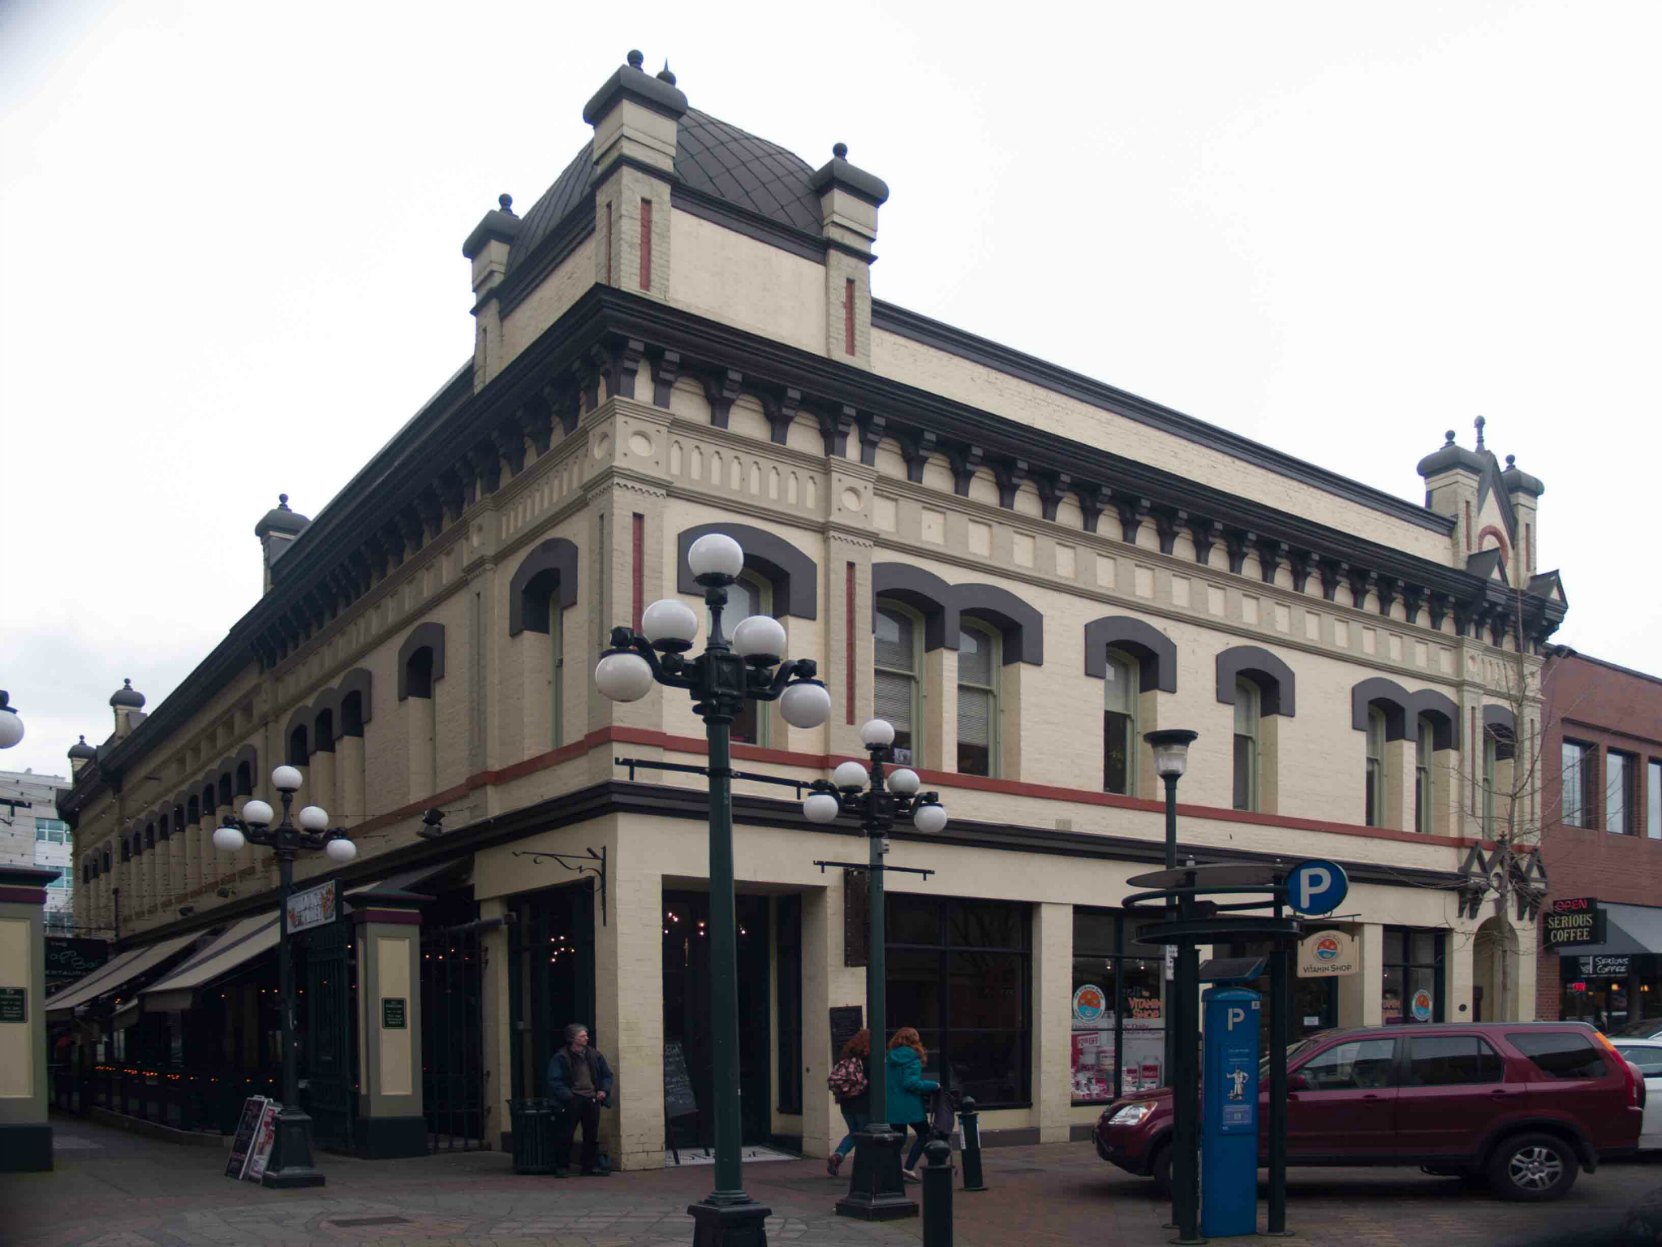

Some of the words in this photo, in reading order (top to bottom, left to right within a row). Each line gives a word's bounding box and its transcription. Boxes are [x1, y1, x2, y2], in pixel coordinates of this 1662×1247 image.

[1300, 867, 1332, 909] P
[1555, 899, 1588, 912] OPEN
[1548, 914, 1593, 929] SERIOUS
[1550, 928, 1590, 943] COFFEE
[1303, 965, 1330, 973] VITAMIN
[1330, 963, 1353, 973] SHOP
[1597, 965, 1627, 973] COFFEE
[1227, 1007, 1245, 1031] P
